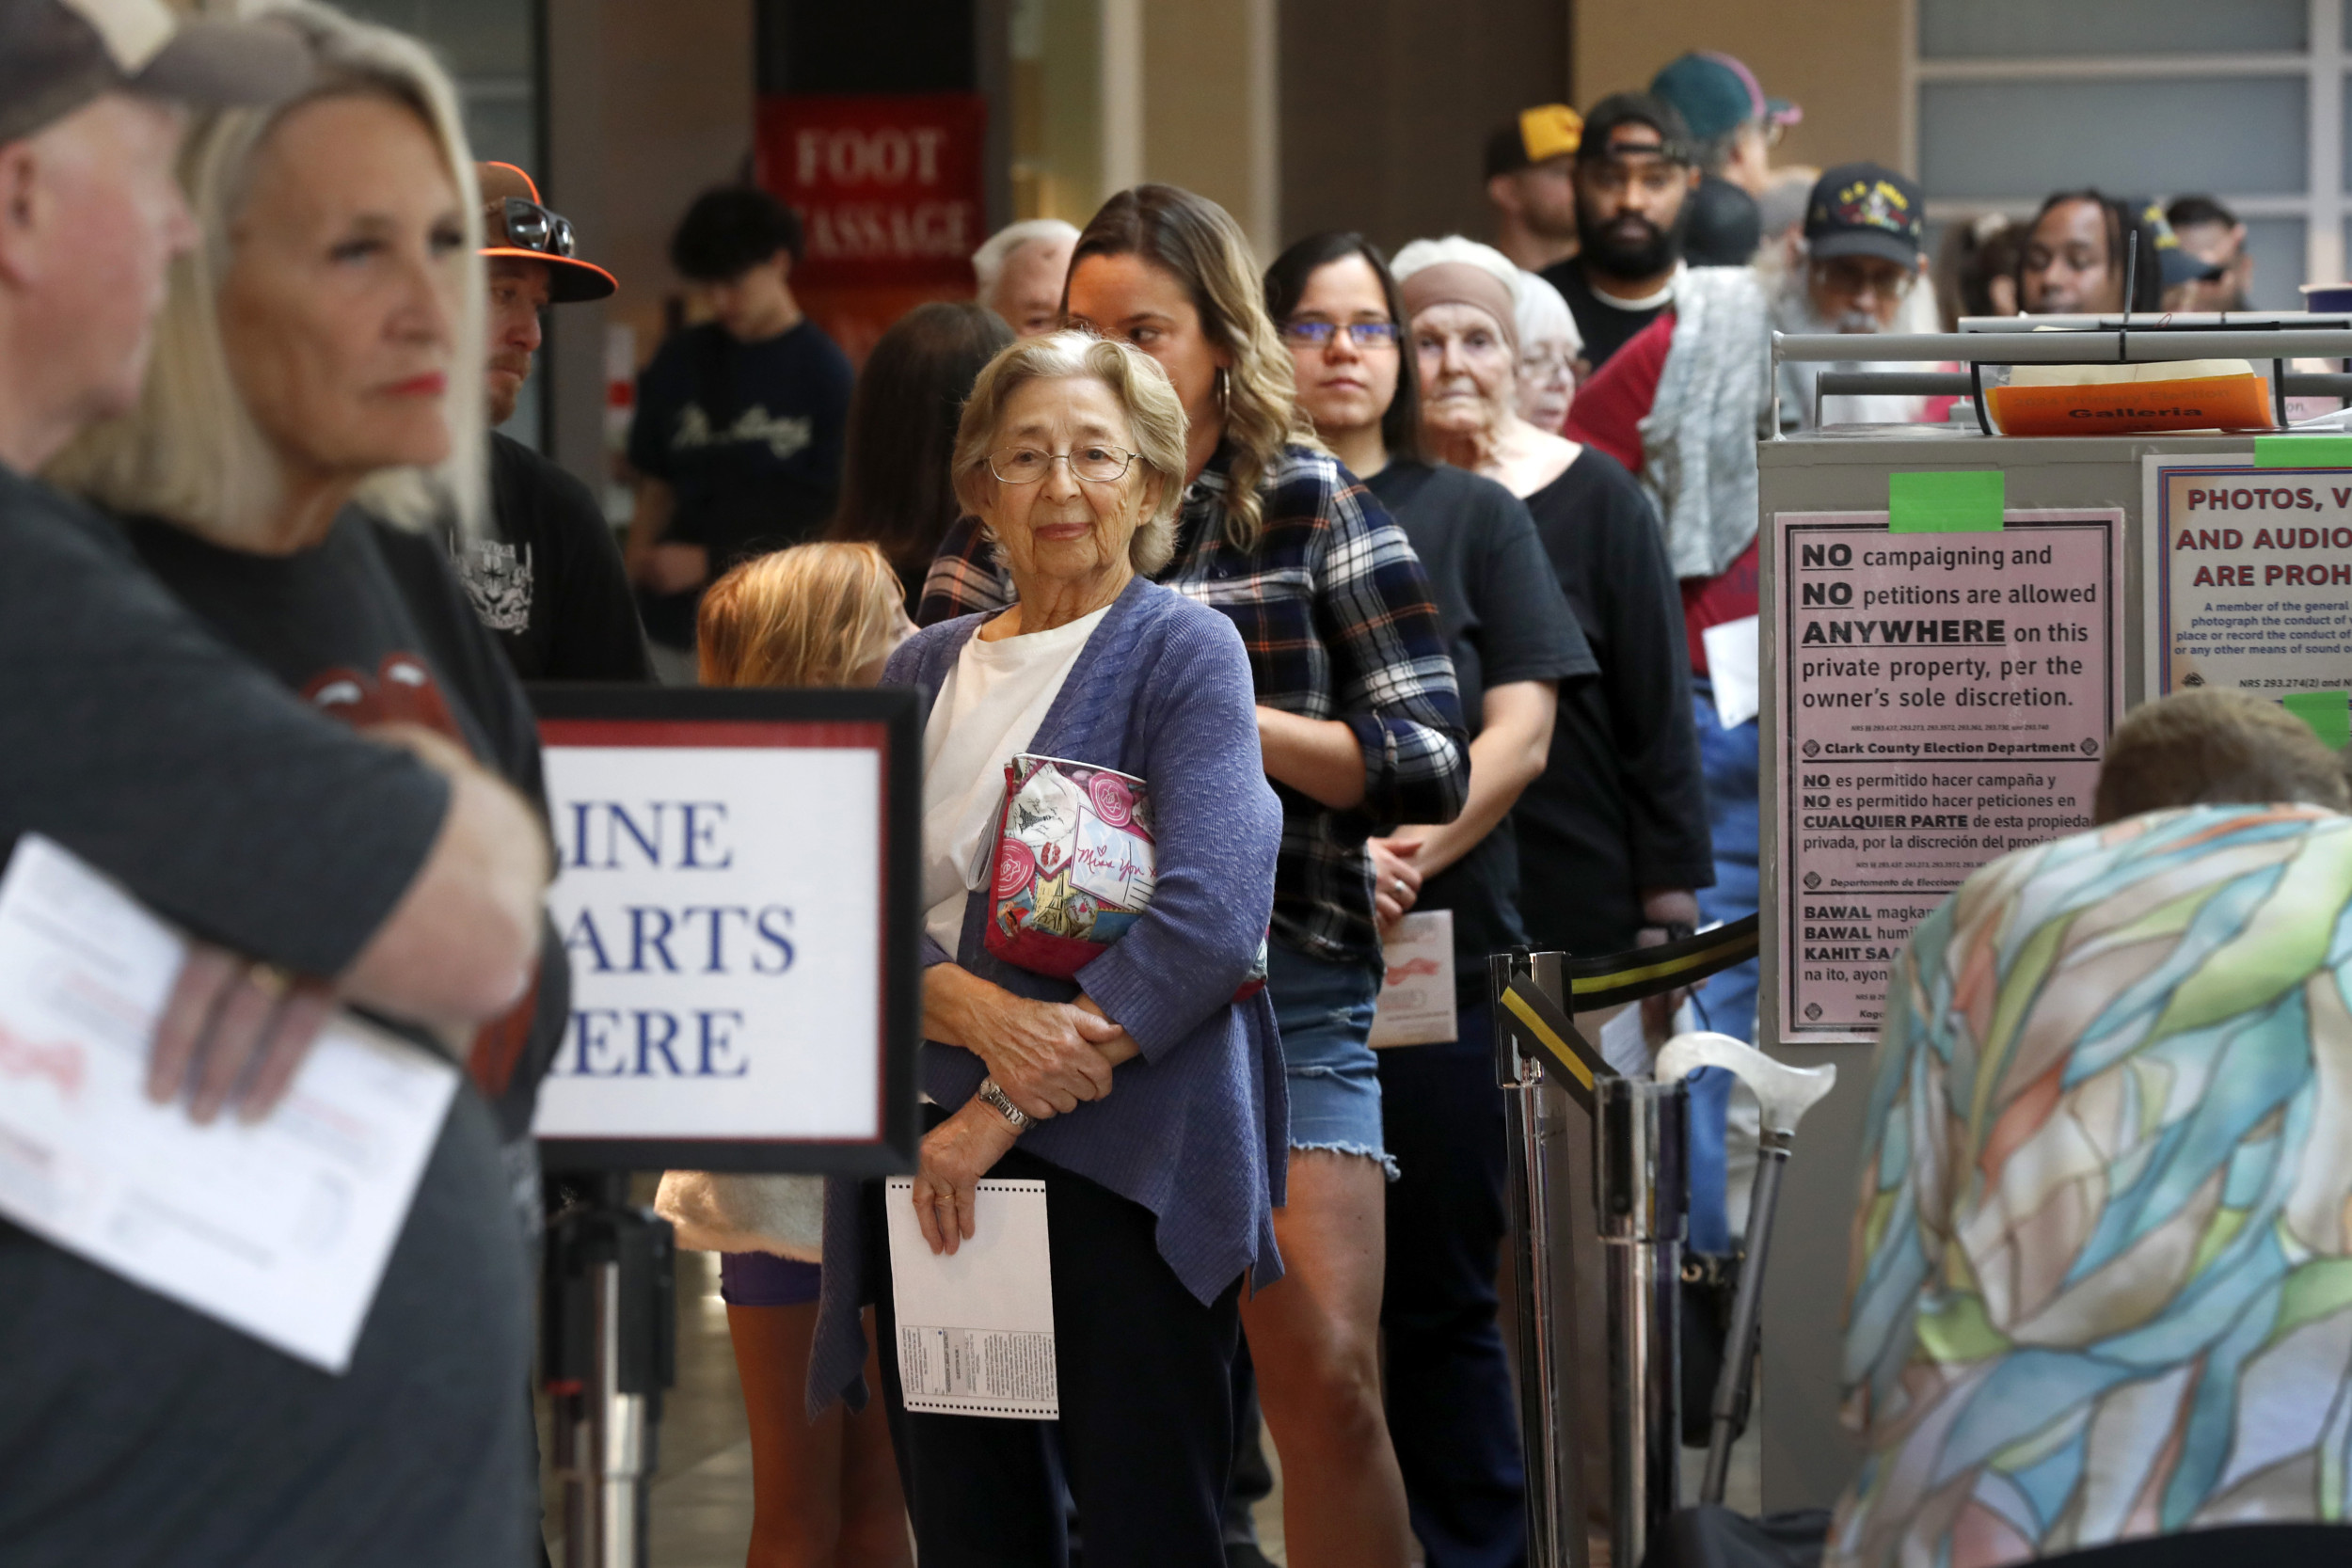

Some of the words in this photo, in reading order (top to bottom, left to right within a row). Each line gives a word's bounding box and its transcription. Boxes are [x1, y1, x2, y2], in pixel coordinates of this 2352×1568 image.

[797, 128, 946, 184] FOOT
[798, 201, 973, 259] ASSAGE
[2068, 408, 2202, 419] Galleria
[2188, 487, 2323, 512] PHOTOS,
[2176, 529, 2243, 550] AND
[2252, 528, 2352, 549] AUDIO
[1802, 543, 1852, 566] NO
[1864, 547, 2004, 571] campaigning
[2011, 545, 2052, 565] and
[2193, 565, 2255, 587] ARE
[1802, 582, 1852, 606] NO
[1864, 585, 1960, 610] petitions
[1967, 589, 2001, 604] are
[2009, 583, 2096, 604] allowed
[2204, 602, 2213, 611] A
[2217, 601, 2263, 611] member
[2267, 601, 2279, 611] of
[2281, 601, 2301, 611] the
[2304, 600, 2349, 613] general
[2191, 617, 2258, 628] photograph
[2262, 616, 2280, 626] the
[2284, 615, 2330, 626] conduct
[2334, 615, 2346, 625] of
[1802, 620, 2006, 643] ANYWHERE
[2014, 627, 2041, 642] on
[2048, 623, 2089, 642] this
[2176, 630, 2208, 641] place
[2211, 632, 2222, 641] or
[2226, 630, 2264, 641] record
[2266, 630, 2286, 640] the
[2289, 629, 2335, 640] conduct
[2339, 629, 2351, 639] of
[2174, 646, 2186, 655] or
[2190, 647, 2211, 657] any
[2214, 644, 2245, 655] other
[2249, 645, 2287, 655] means
[2290, 643, 2302, 654] of
[2305, 643, 2341, 654] sound
[1803, 658, 1880, 682] private
[1890, 657, 1991, 681] property,
[2000, 660, 2037, 679] per
[2046, 656, 2082, 675] the
[2239, 679, 2261, 689] NRS
[2263, 678, 2319, 689] 293.274(2)
[2321, 678, 2341, 688] and
[1803, 688, 1890, 707] owner's
[1899, 688, 1946, 706] sole
[1956, 688, 2073, 706] discretion.
[1825, 742, 1865, 753] Clark
[1867, 742, 1920, 756] County
[1924, 741, 1984, 753] Election
[1987, 741, 2076, 756] Department
[1804, 774, 1831, 787] NO
[1836, 777, 1852, 787] es
[1856, 773, 1928, 790] permitido
[1931, 773, 1973, 787] hacer
[1977, 773, 2043, 790] campaña
[2048, 776, 2057, 789] y
[1804, 795, 1831, 808] NO
[1836, 798, 1852, 808] es
[1856, 794, 1928, 811] permitido
[1931, 793, 1973, 807] hacer
[1978, 794, 2054, 810] peticiones
[2058, 796, 2076, 807] en
[1804, 815, 1907, 829] CUALQUIER
[1911, 815, 1968, 828] PARTE
[1973, 814, 1991, 828] de
[1994, 816, 2024, 828] esta
[1804, 835, 1859, 852] privada,
[1863, 837, 1885, 852] por
[1890, 834, 1904, 848] la
[1908, 834, 1978, 848] discreción
[1982, 834, 2005, 847] del
[1830, 879, 1899, 888] Departamento
[1902, 879, 1914, 887] de
[1804, 906, 1871, 919] BAWAL
[1804, 927, 1871, 940] BAWAL
[1804, 947, 1861, 960] KAHIT
[1804, 970, 1822, 981] na
[1826, 968, 1849, 982] ito,
[1852, 969, 1888, 985] ayon
